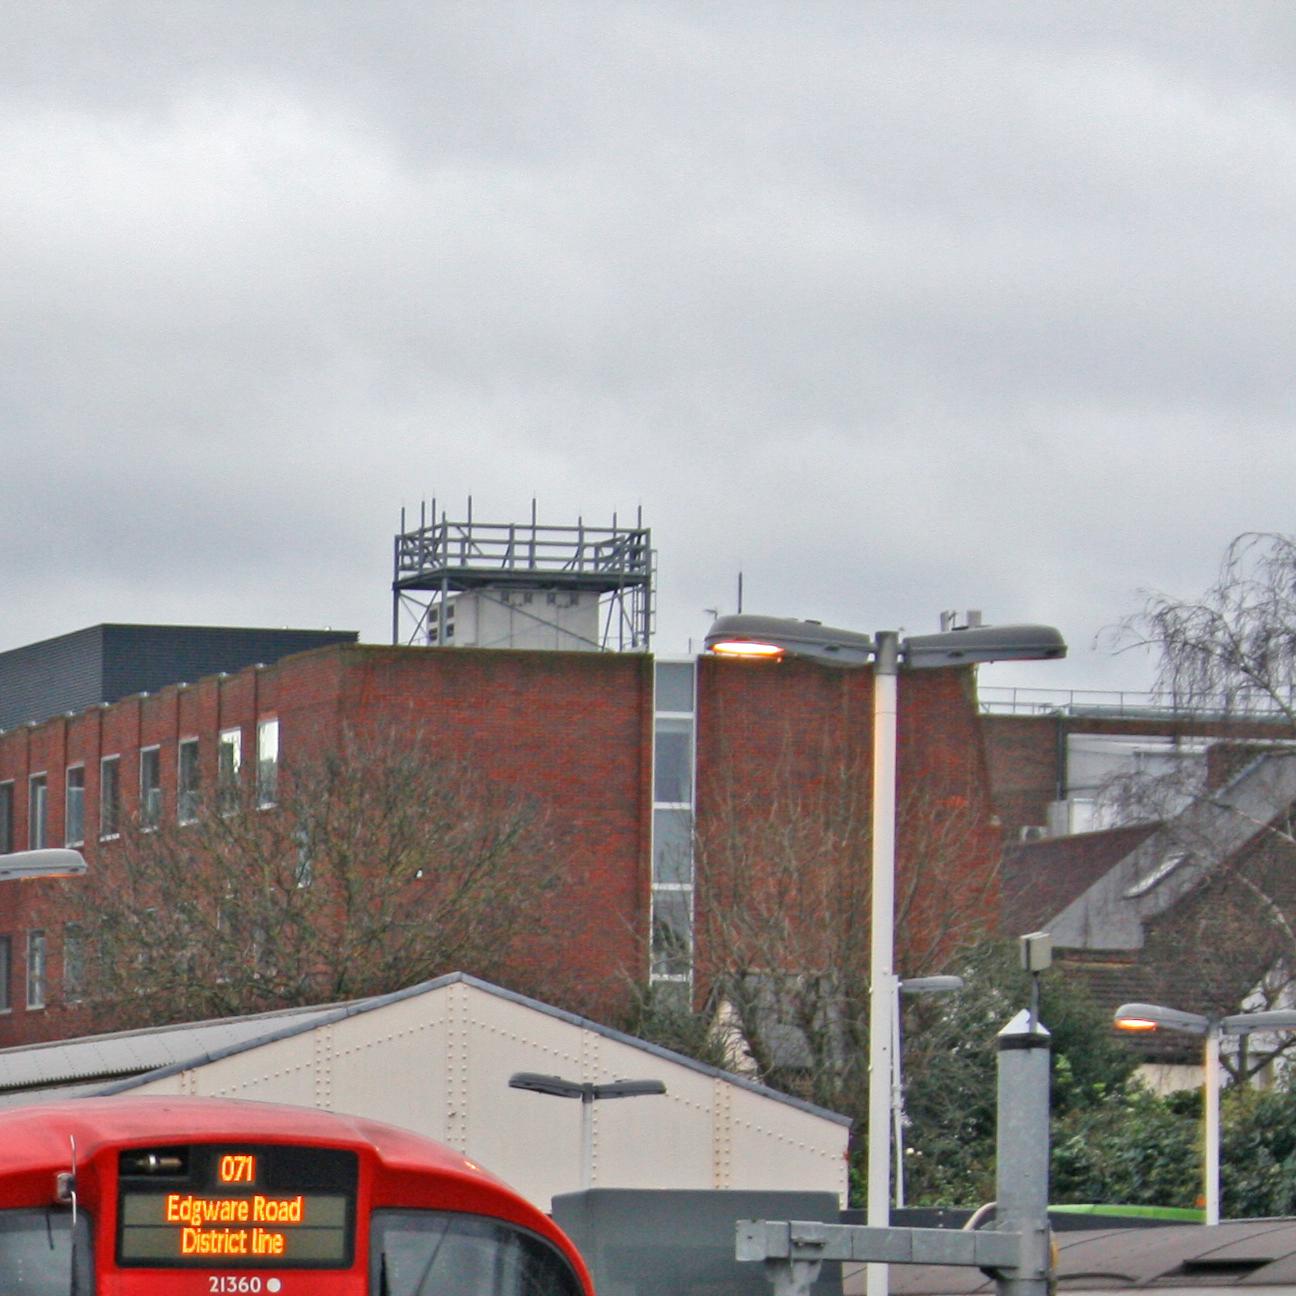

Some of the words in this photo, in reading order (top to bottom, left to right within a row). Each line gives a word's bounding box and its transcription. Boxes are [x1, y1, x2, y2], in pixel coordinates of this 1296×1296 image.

[220, 1155, 256, 1183] 071
[166, 1194, 248, 1226] Edgware
[252, 1195, 304, 1222] Road
[181, 1227, 247, 1254] District
[252, 1227, 285, 1254] line
[209, 1276, 261, 1294] 21360
